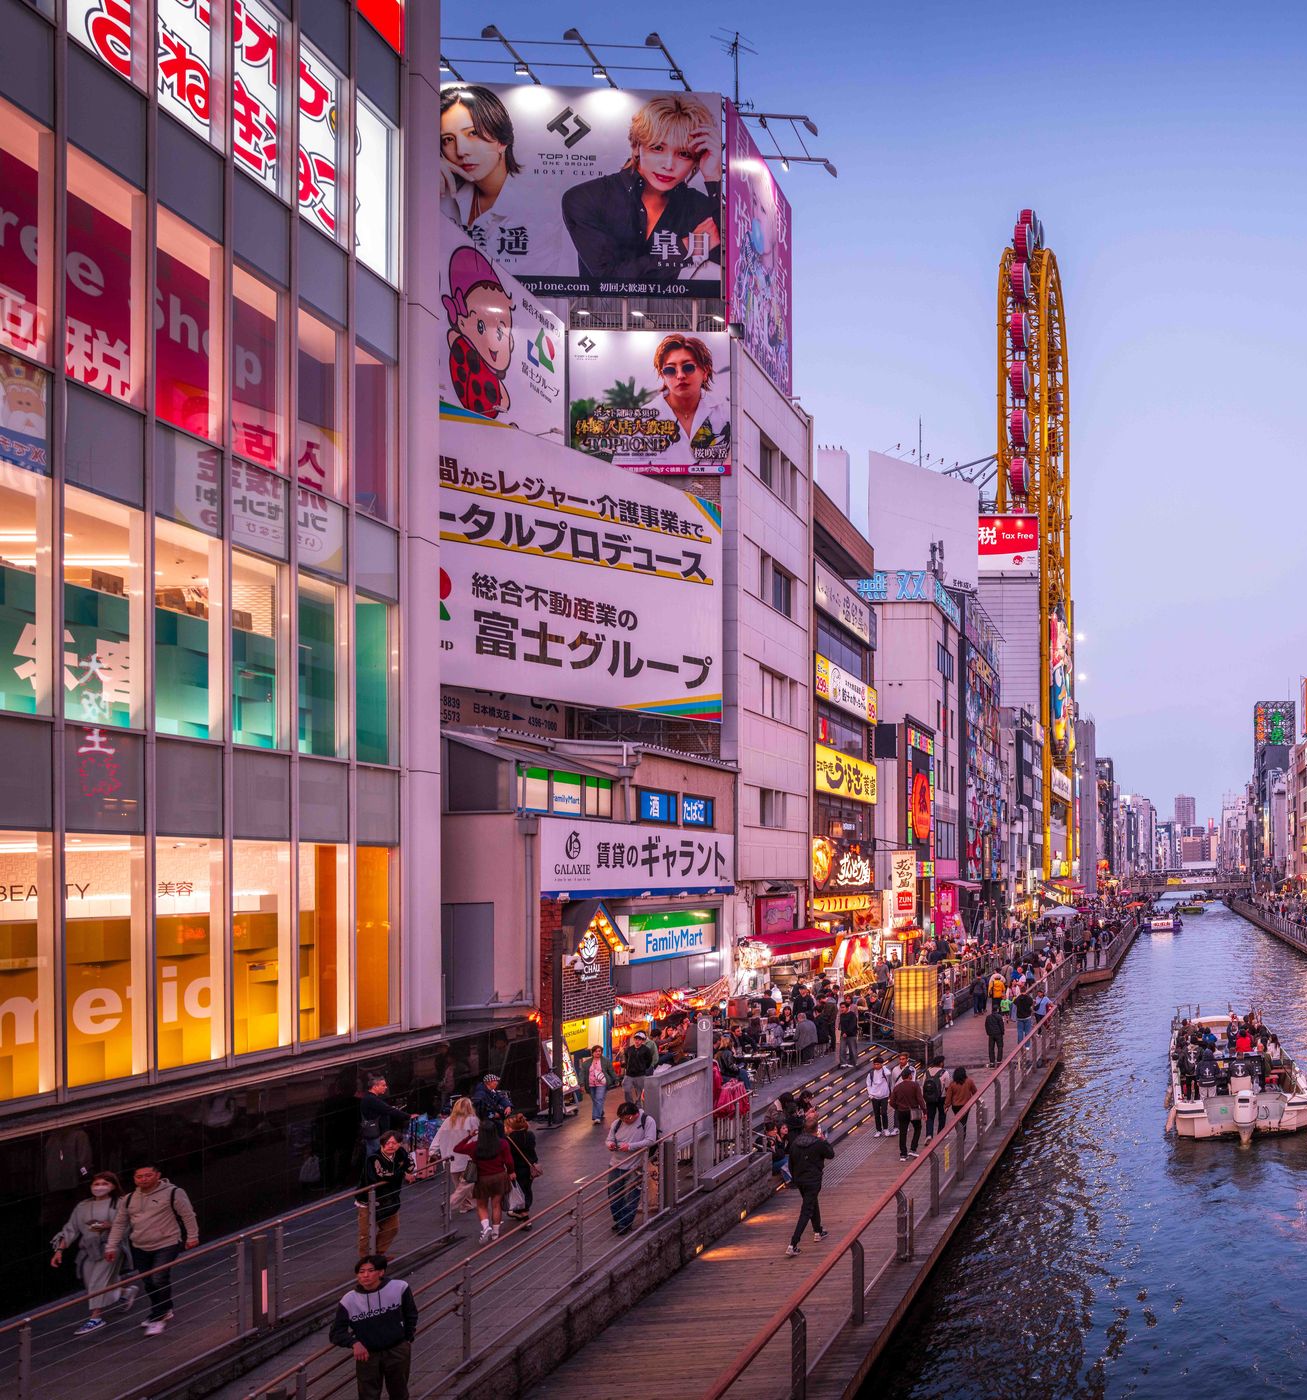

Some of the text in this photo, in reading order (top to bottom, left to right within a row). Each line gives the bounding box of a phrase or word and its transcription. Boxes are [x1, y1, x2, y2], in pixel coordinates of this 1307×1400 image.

[538, 153, 597, 161] TOP1ONE
[533, 168, 565, 176] HOST
[575, 418, 677, 436] 体験入店大歓迎
[977, 526, 1035, 545] 税 Tax Free
[471, 572, 638, 633] 総合不動産業の
[473, 610, 713, 689] 富士グループ
[825, 755, 863, 797] うなぎ
[649, 796, 660, 818] 酒
[683, 800, 706, 822] たばこ
[596, 835, 726, 878] 賃貸のギャラント
[0, 882, 91, 903] BEATY
[157, 882, 194, 898] 美容
[645, 928, 703, 954] FamilyMart
[0, 965, 212, 1046] meic
[351, 1306, 387, 1322] adidas
